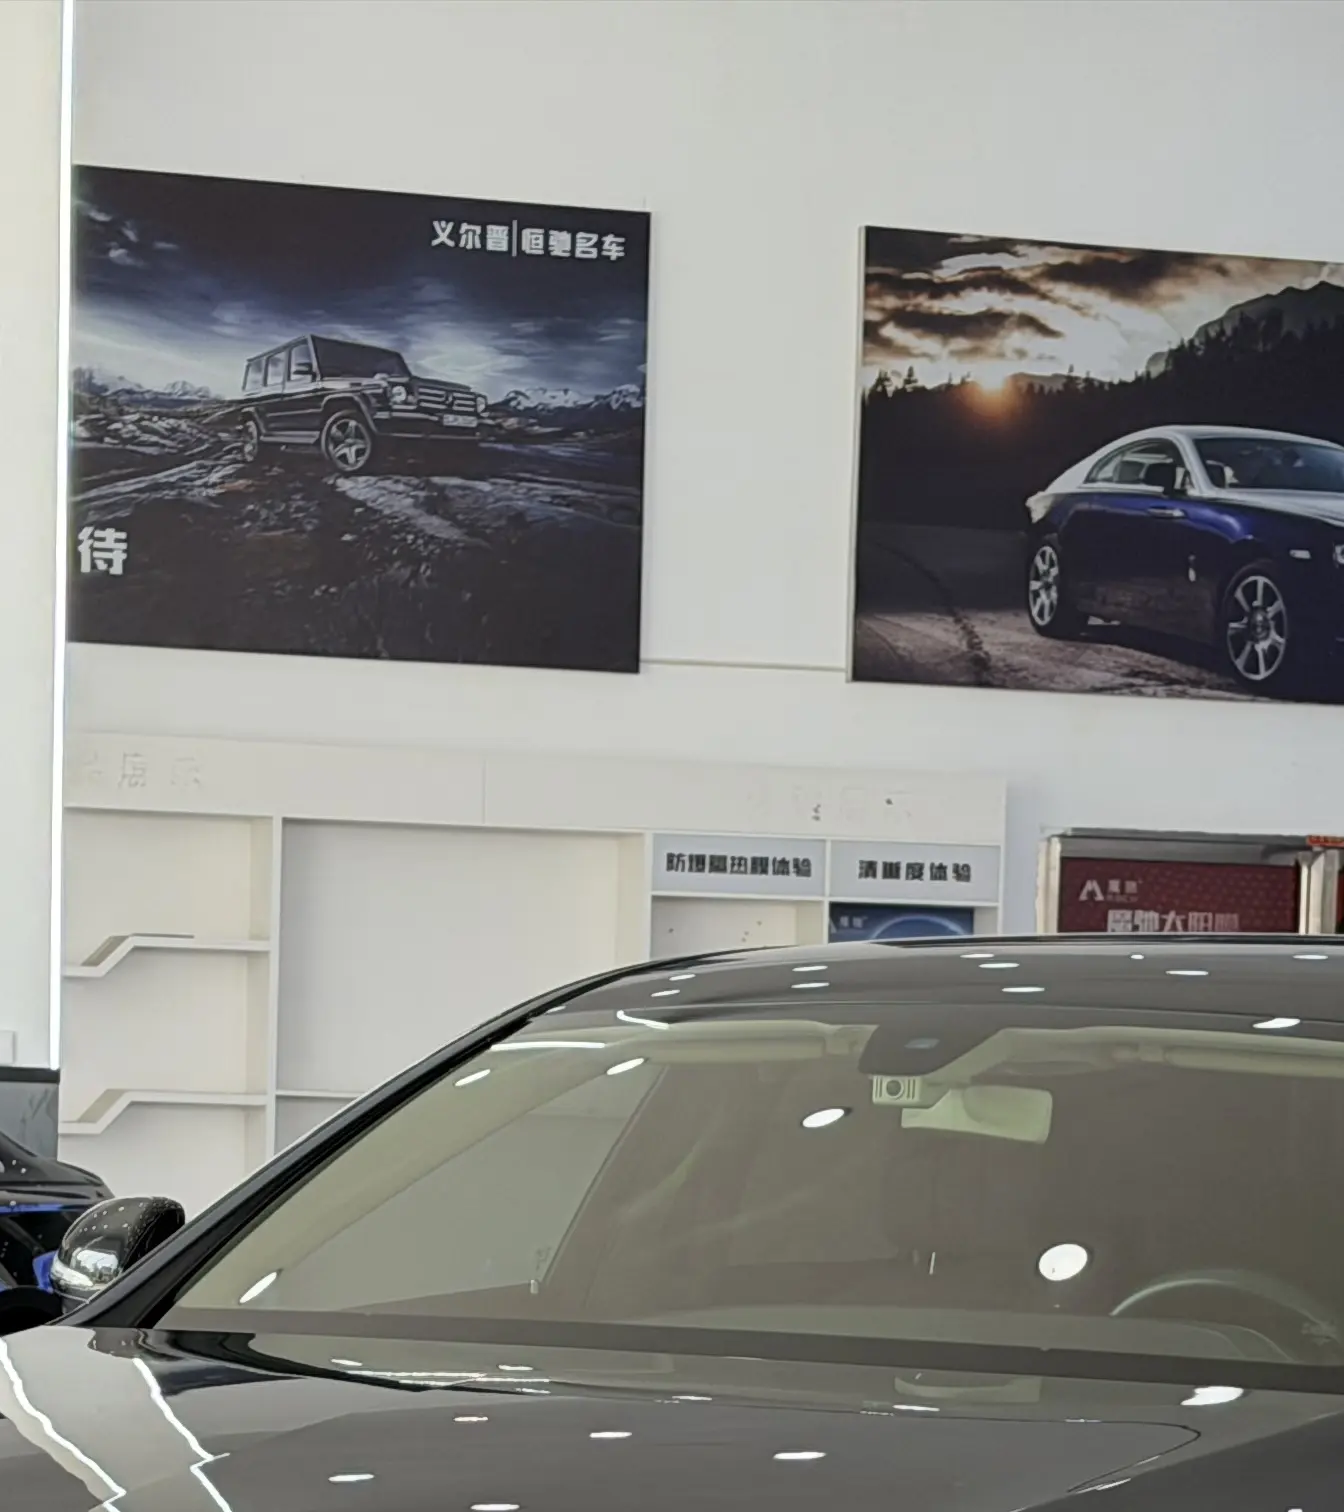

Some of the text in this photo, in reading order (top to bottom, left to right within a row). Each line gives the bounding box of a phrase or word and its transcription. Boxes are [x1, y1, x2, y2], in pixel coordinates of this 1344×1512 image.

[521, 228, 626, 261] 恒驰名车
[77, 526, 128, 575] 待
